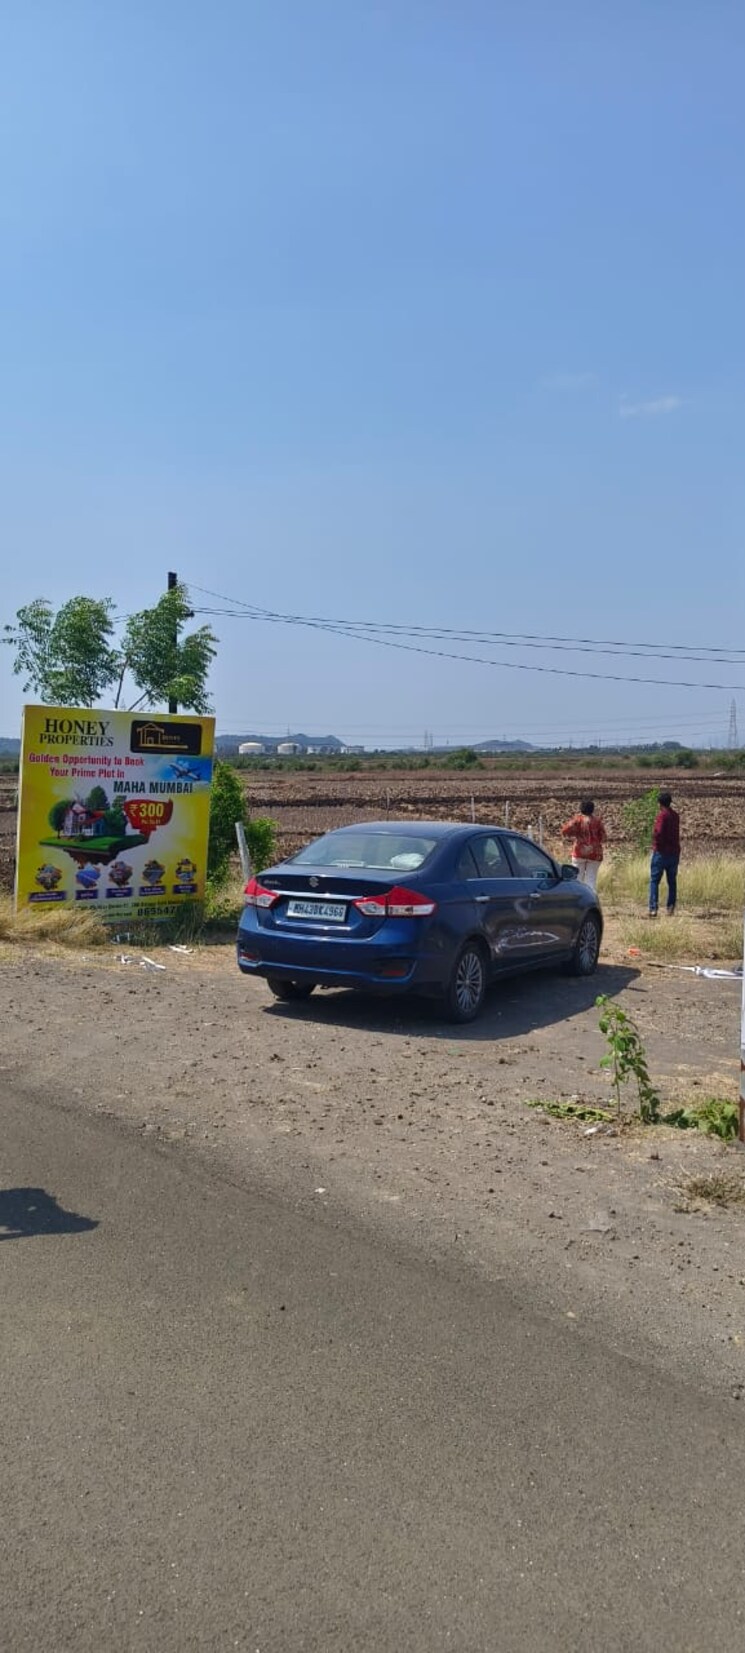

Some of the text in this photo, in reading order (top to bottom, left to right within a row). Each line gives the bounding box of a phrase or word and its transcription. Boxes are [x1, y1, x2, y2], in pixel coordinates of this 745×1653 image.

[45, 717, 111, 736] HONEY
[39, 733, 114, 747] PROPERTIES
[29, 752, 144, 767] Golden Opportunity to Book
[50, 767, 125, 778] Your Prime Plot in
[113, 780, 193, 794] MAHA MUMBAI
